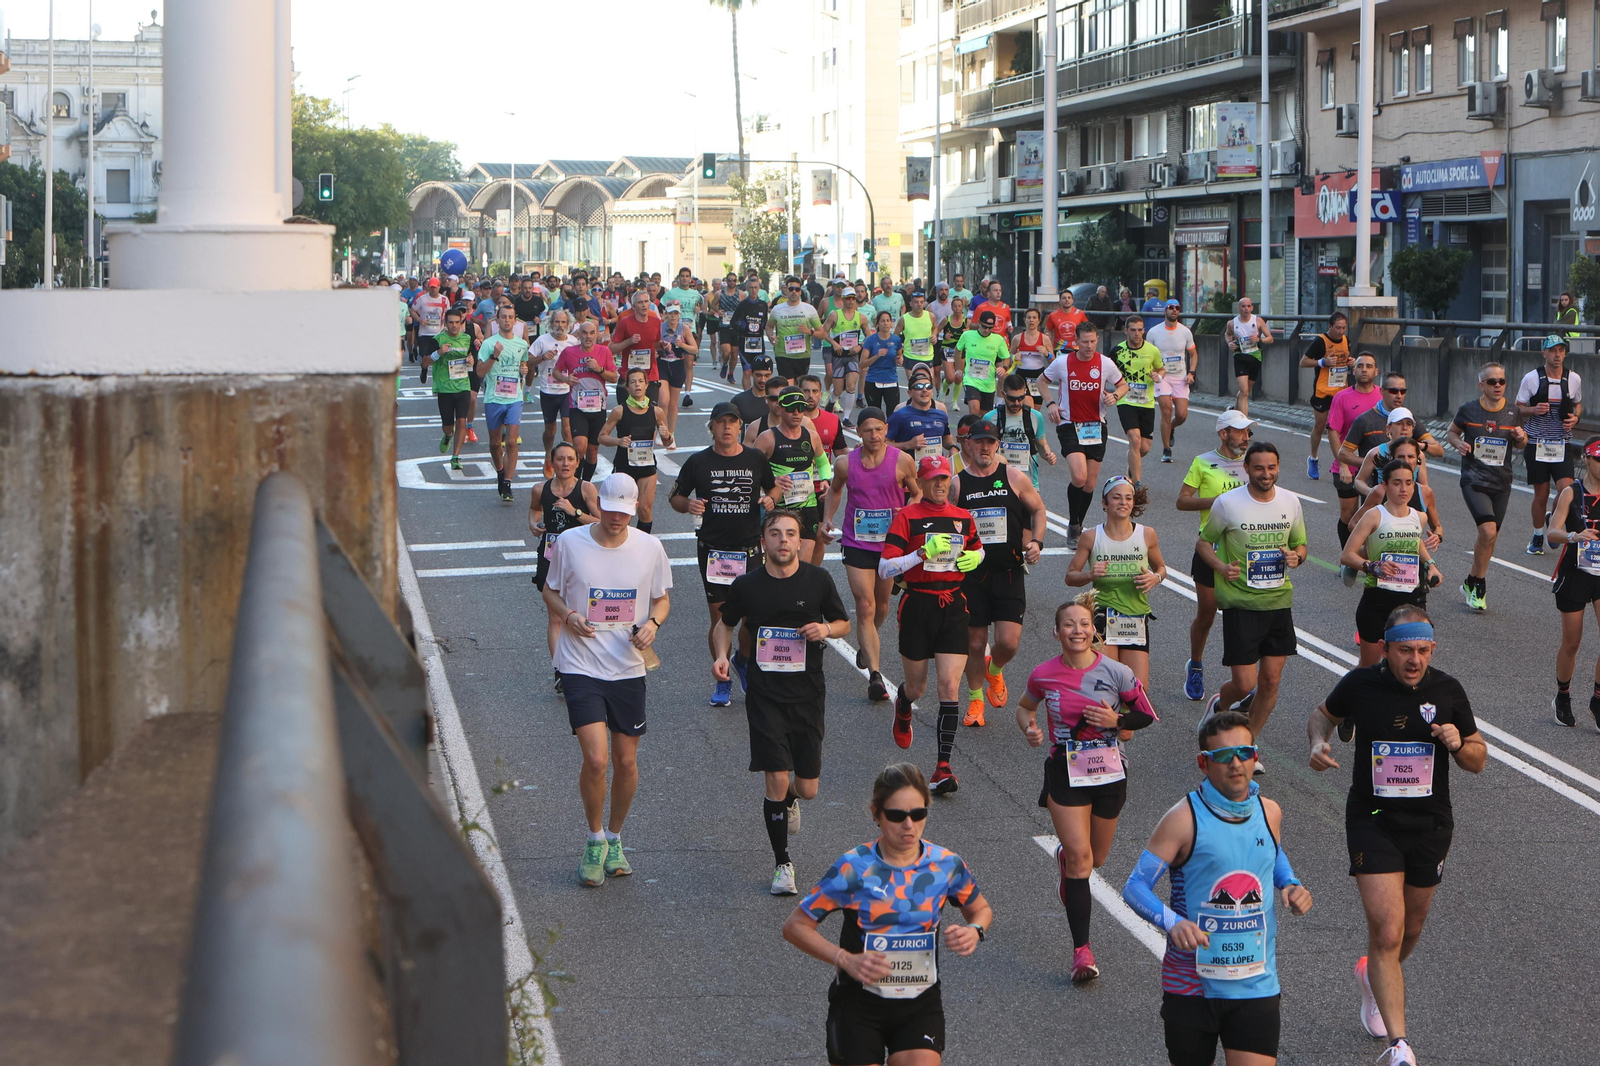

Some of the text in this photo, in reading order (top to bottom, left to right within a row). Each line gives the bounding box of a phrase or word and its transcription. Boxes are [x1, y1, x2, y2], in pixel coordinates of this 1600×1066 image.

[1416, 165, 1480, 184] AUTOCLIMA SPORT, S.L.
[726, 468, 753, 477] TRIATLÓN
[966, 490, 1008, 501] IRELAND
[1240, 522, 1290, 530] C.D.RUNNING
[1250, 532, 1284, 543] sano
[1386, 540, 1418, 550] sano
[1087, 756, 1104, 764] 7022
[1394, 765, 1413, 773] 7625
[1222, 919, 1257, 930] ZURICH
[891, 939, 927, 948] ZURICH
[1222, 943, 1244, 952] 6539
[1232, 955, 1254, 964] LÓPEZ
[880, 975, 928, 984] HERRERAVAZ
